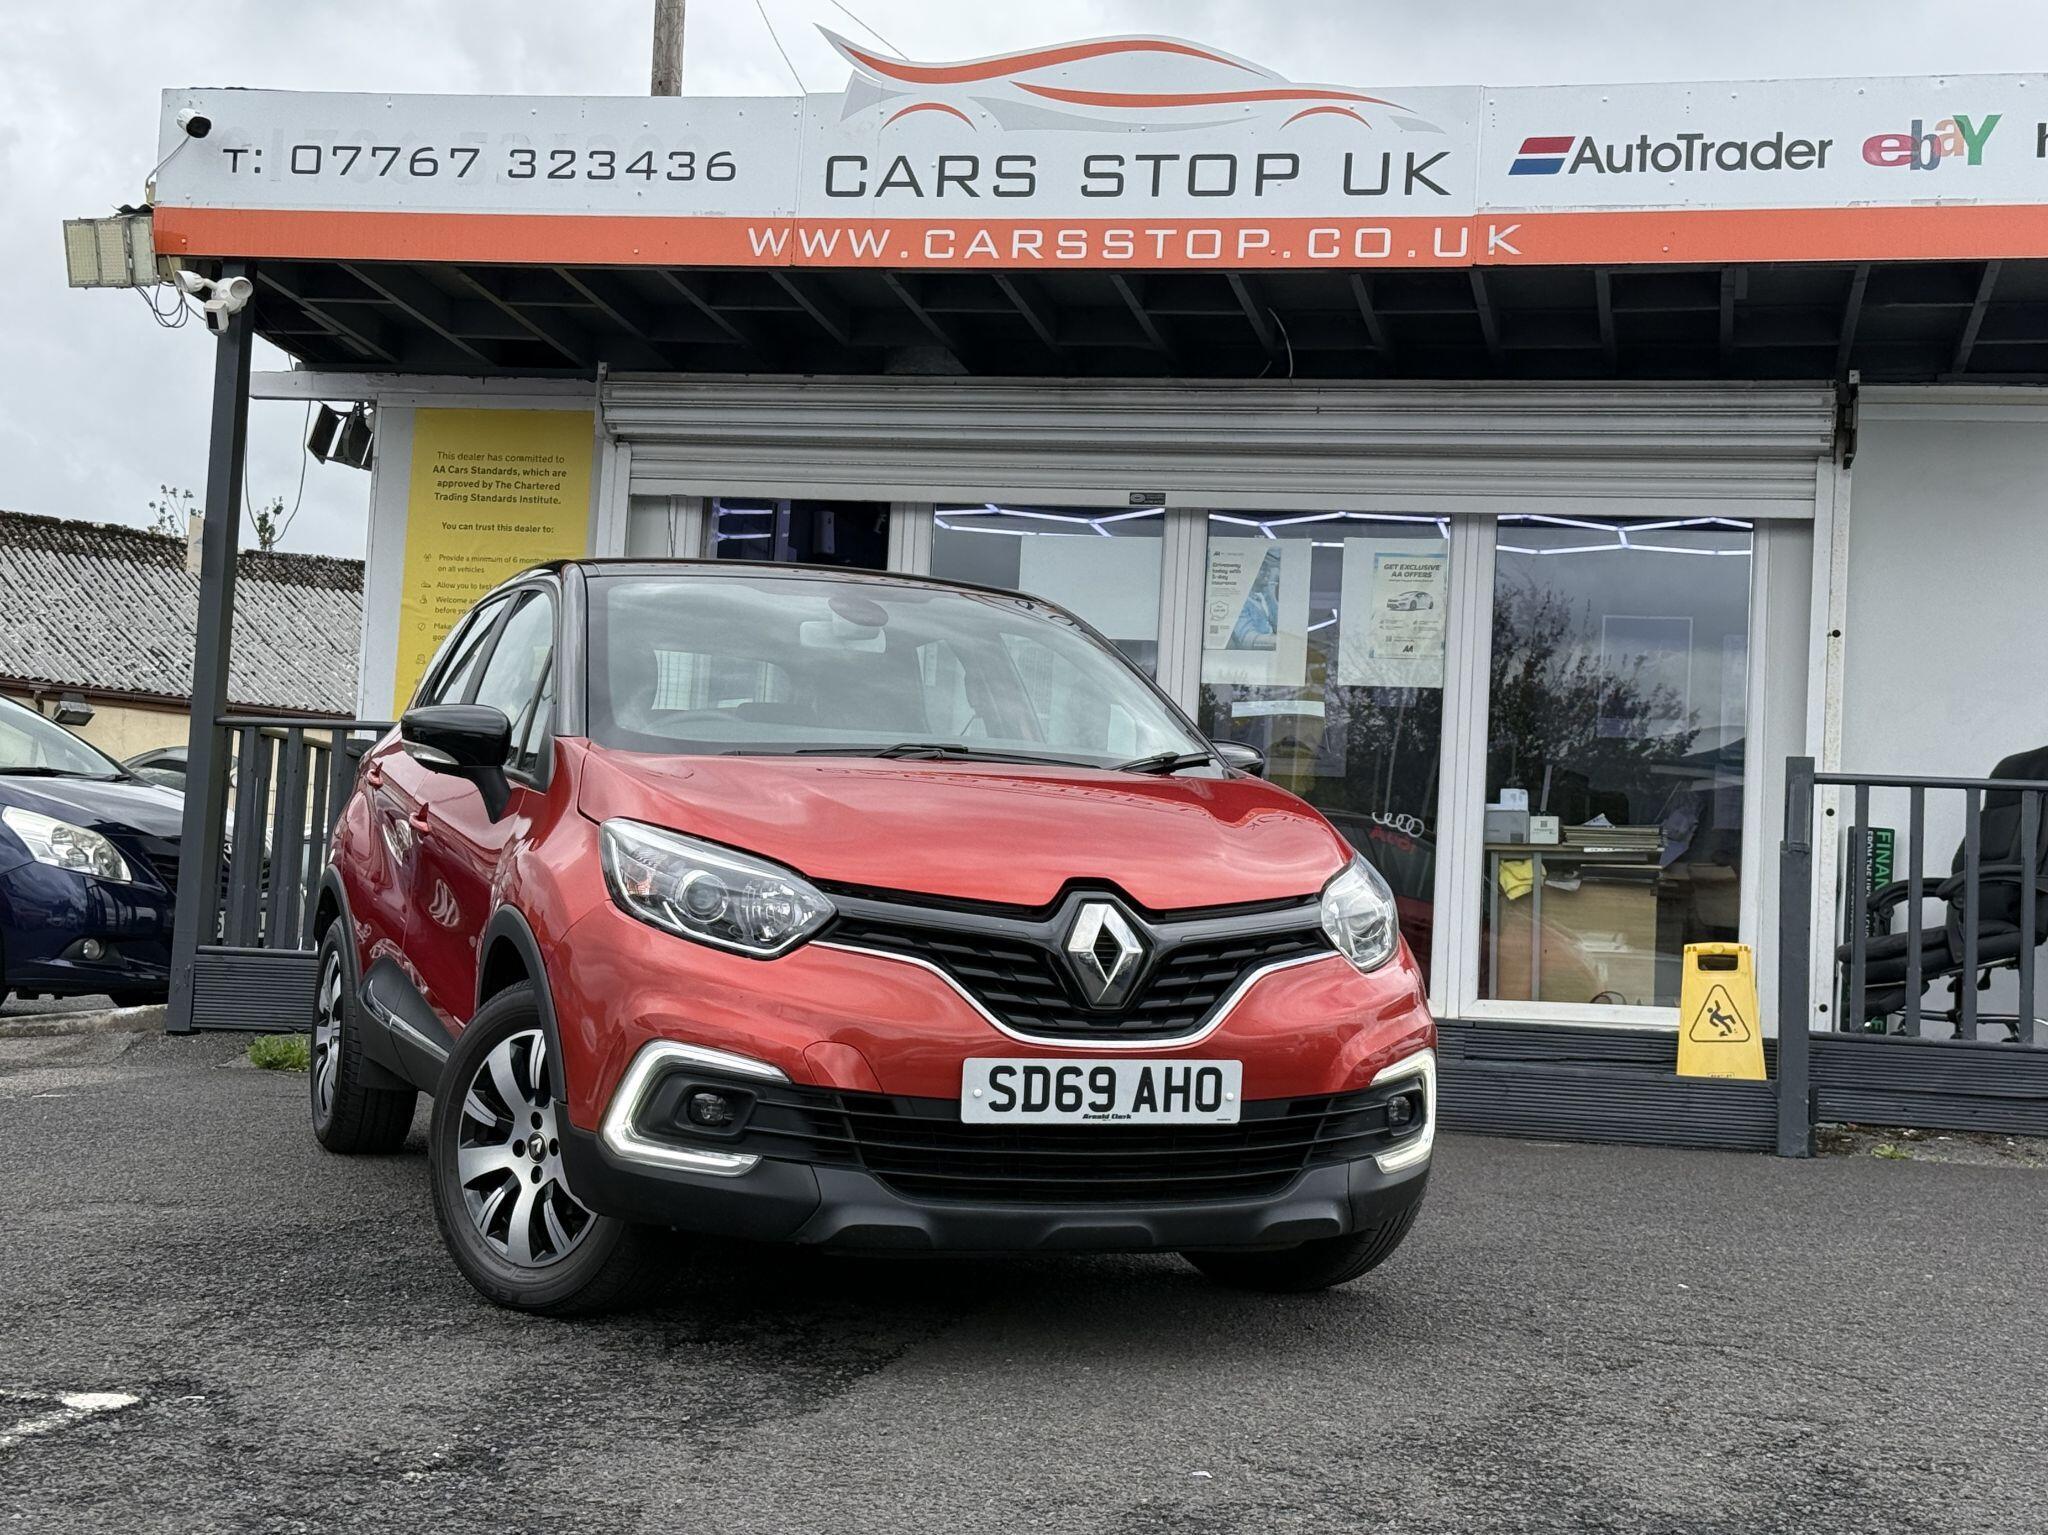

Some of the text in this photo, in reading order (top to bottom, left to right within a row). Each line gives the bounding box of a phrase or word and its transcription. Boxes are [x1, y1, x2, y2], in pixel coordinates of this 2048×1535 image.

[1567, 131, 1833, 175] AutoTrader
[222, 144, 738, 184] T: 07767 323436
[825, 151, 1452, 199] CARS STOP UK
[747, 224, 1523, 260] WWW.CARSSTOP.CO.UK
[437, 451, 565, 464] This dealer has committed to
[432, 465, 567, 478] AA Cars Standards, which are
[437, 480, 560, 491] approved by The Chartered
[434, 492, 562, 504] Trading Standards Institute.
[442, 522, 457, 530] You
[475, 523, 495, 532] trust
[497, 523, 512, 532] this
[514, 524, 541, 533] dealer
[542, 526, 554, 534] to:
[439, 554, 464, 562] Provide
[458, 566, 484, 574] vehicles
[436, 582, 456, 590] Allow
[435, 606, 456, 614] before
[1402, 645, 1414, 653] AA
[988, 1065, 1223, 1113] SD69 AHO
